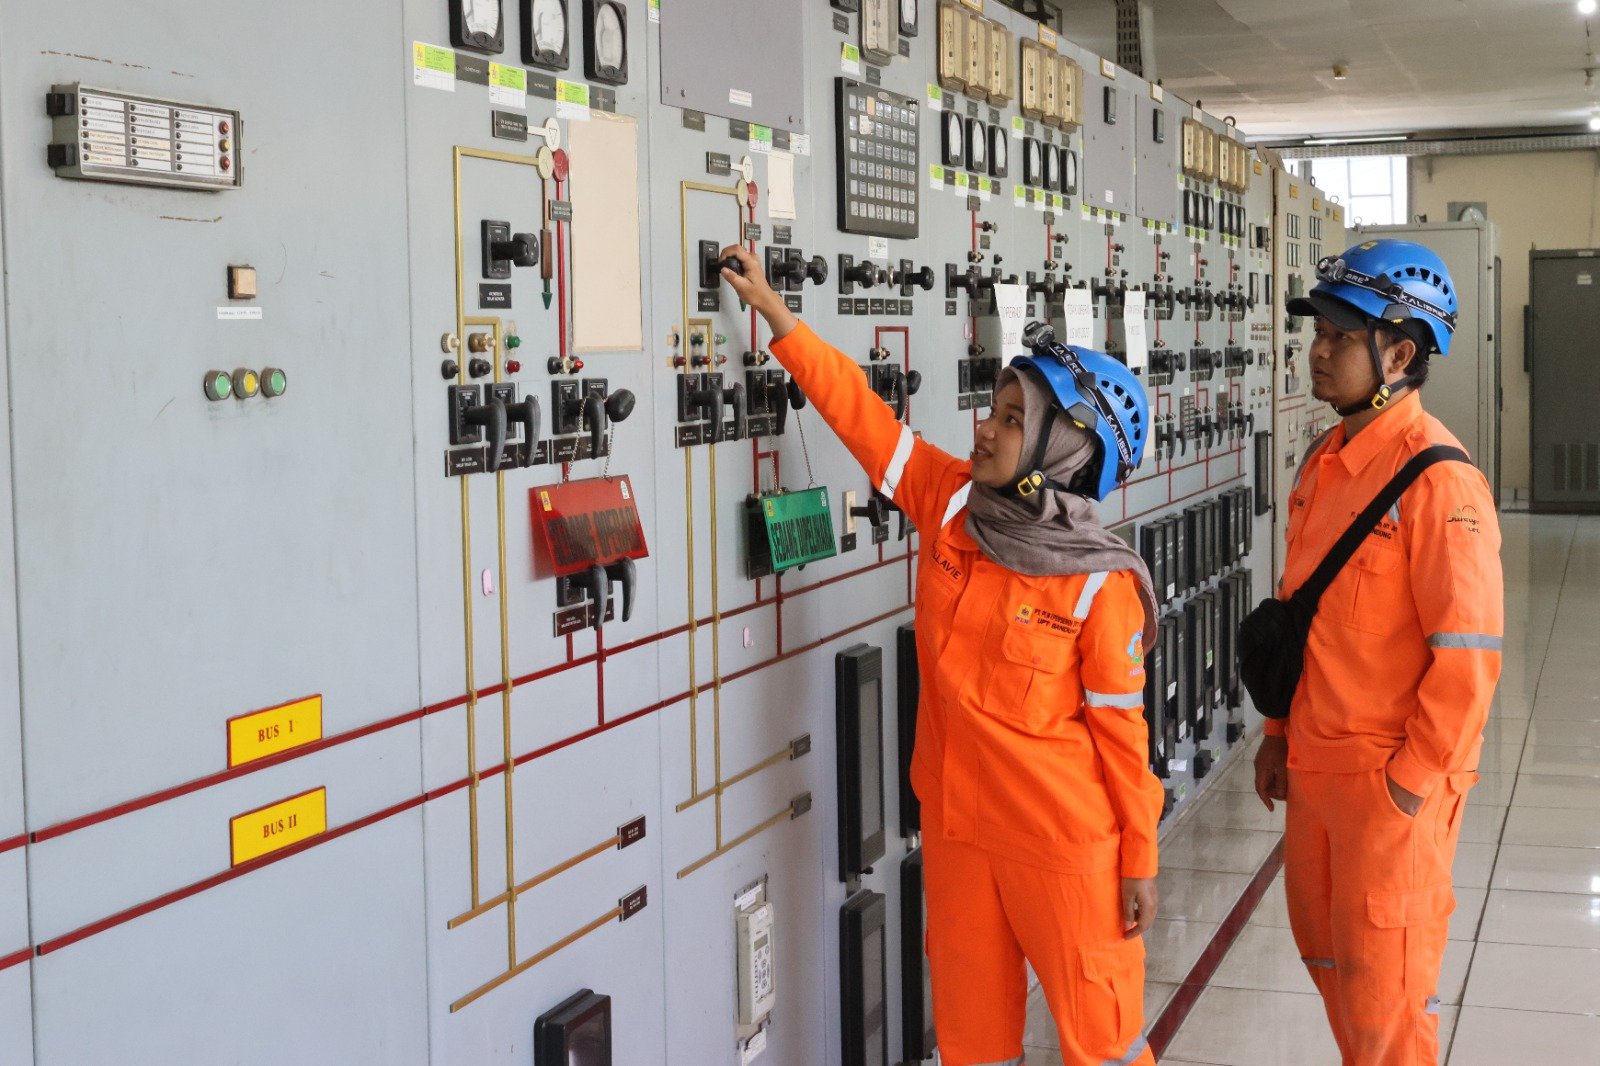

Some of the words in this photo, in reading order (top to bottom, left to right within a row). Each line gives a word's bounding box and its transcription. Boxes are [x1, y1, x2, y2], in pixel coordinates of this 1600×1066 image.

[1400, 293, 1444, 319] KALIBRE
[258, 724, 280, 743] BUS
[288, 720, 294, 733] I
[263, 819, 285, 838] BUS
[288, 813, 298, 829] II
